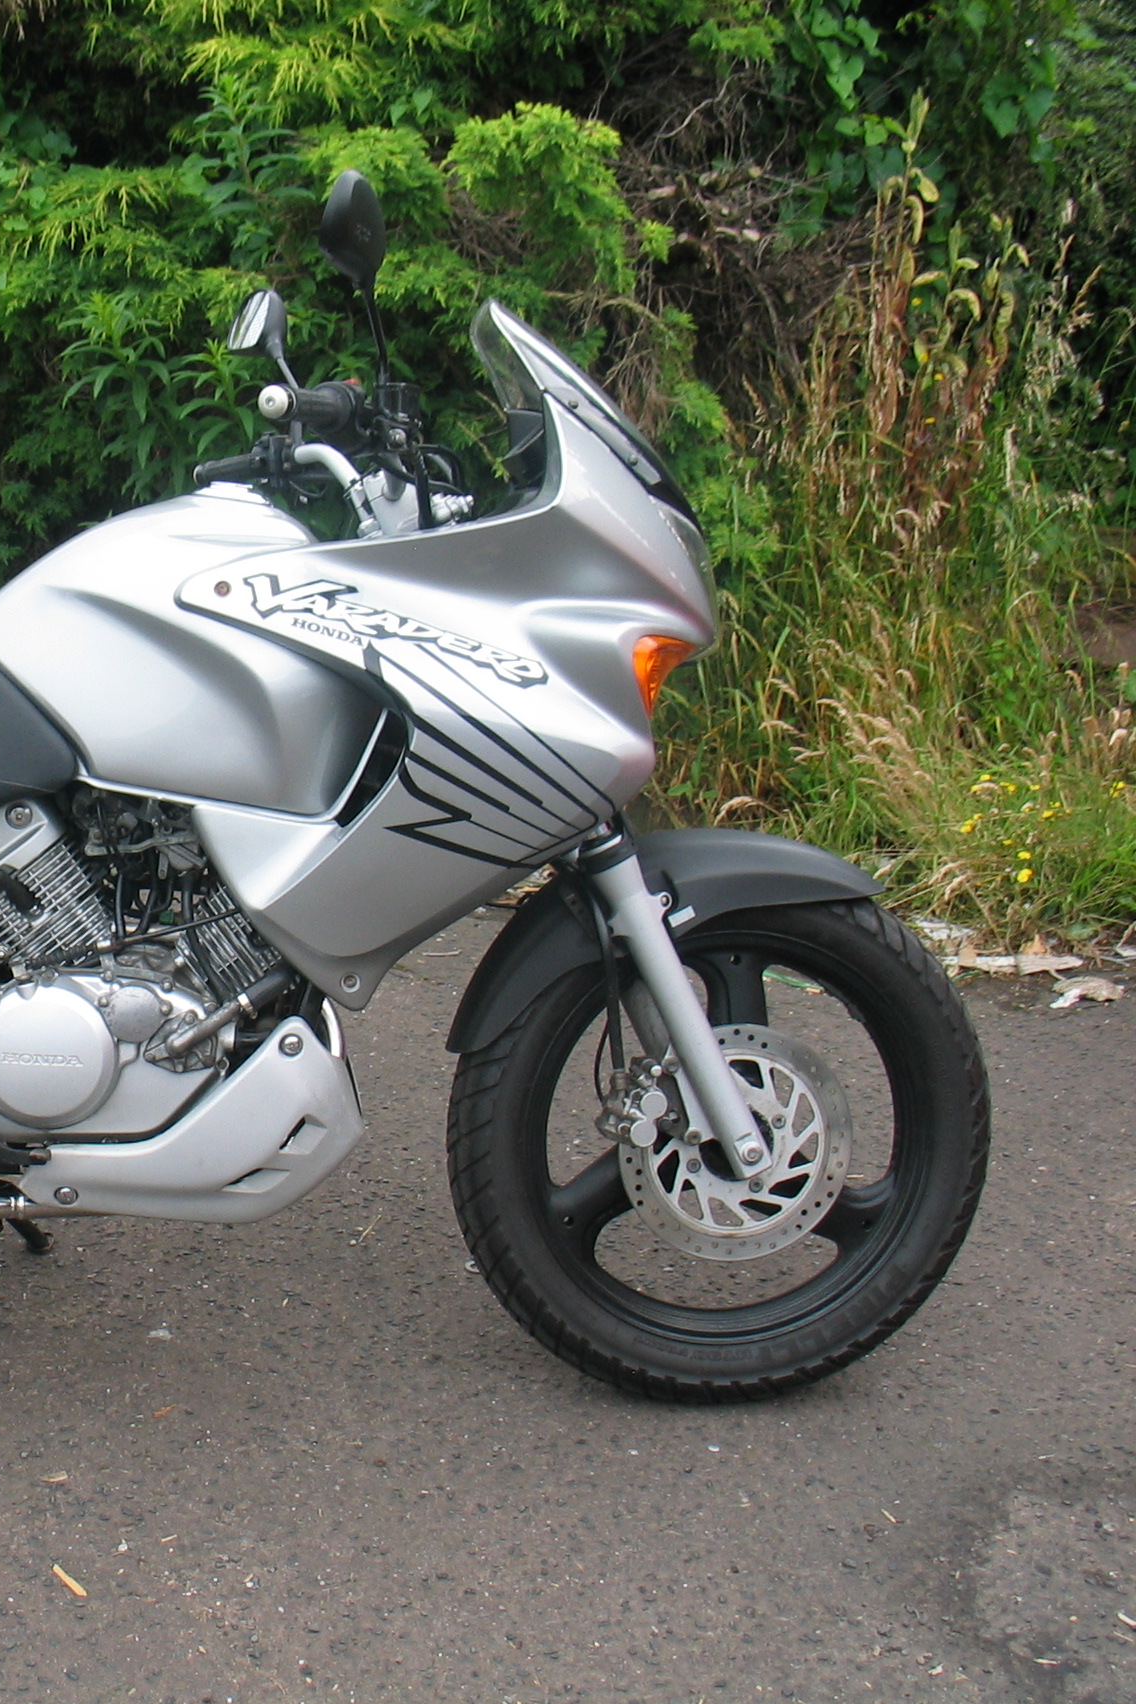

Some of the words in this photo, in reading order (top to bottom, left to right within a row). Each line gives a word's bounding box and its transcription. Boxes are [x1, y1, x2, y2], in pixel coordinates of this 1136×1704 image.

[243, 573, 549, 689] VARADERO
[291, 617, 364, 647] HONDA
[0, 1051, 84, 1068] HONDA
